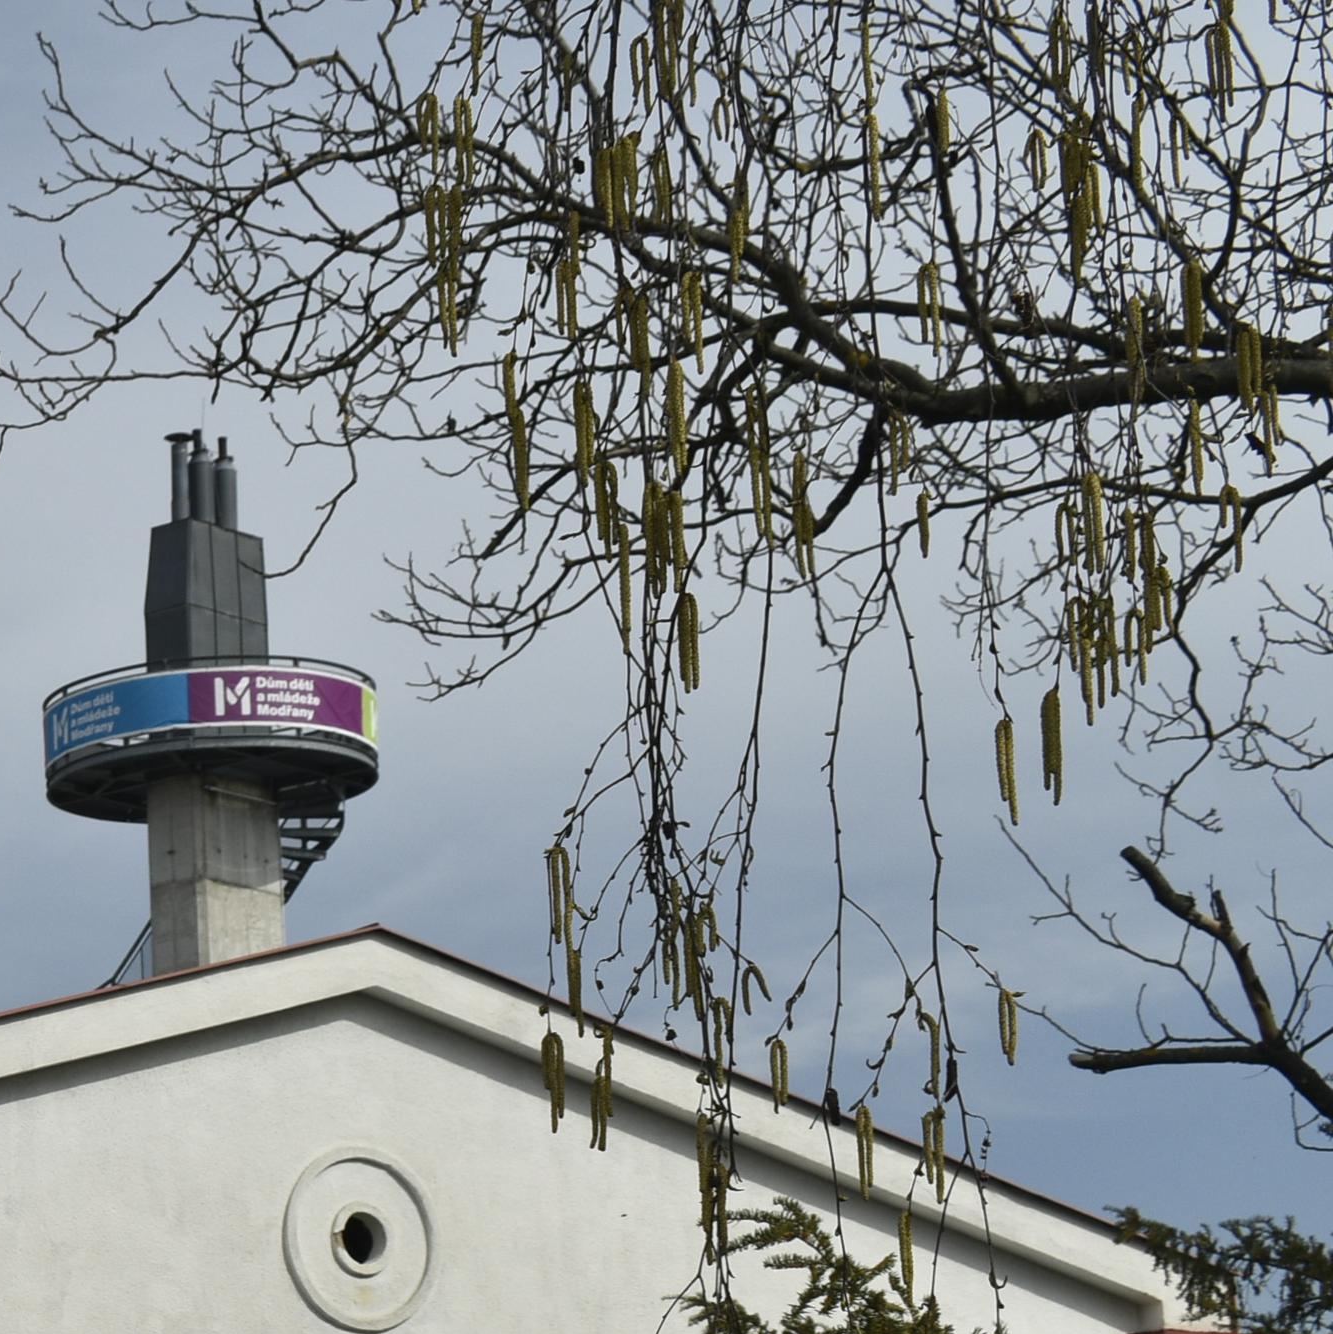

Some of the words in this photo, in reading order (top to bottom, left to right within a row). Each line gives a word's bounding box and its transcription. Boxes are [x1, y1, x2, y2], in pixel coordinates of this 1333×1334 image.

[256, 676, 288, 689] Dům
[256, 693, 265, 702] a
[267, 691, 320, 705] mládeže
[257, 704, 315, 720] Modřany
